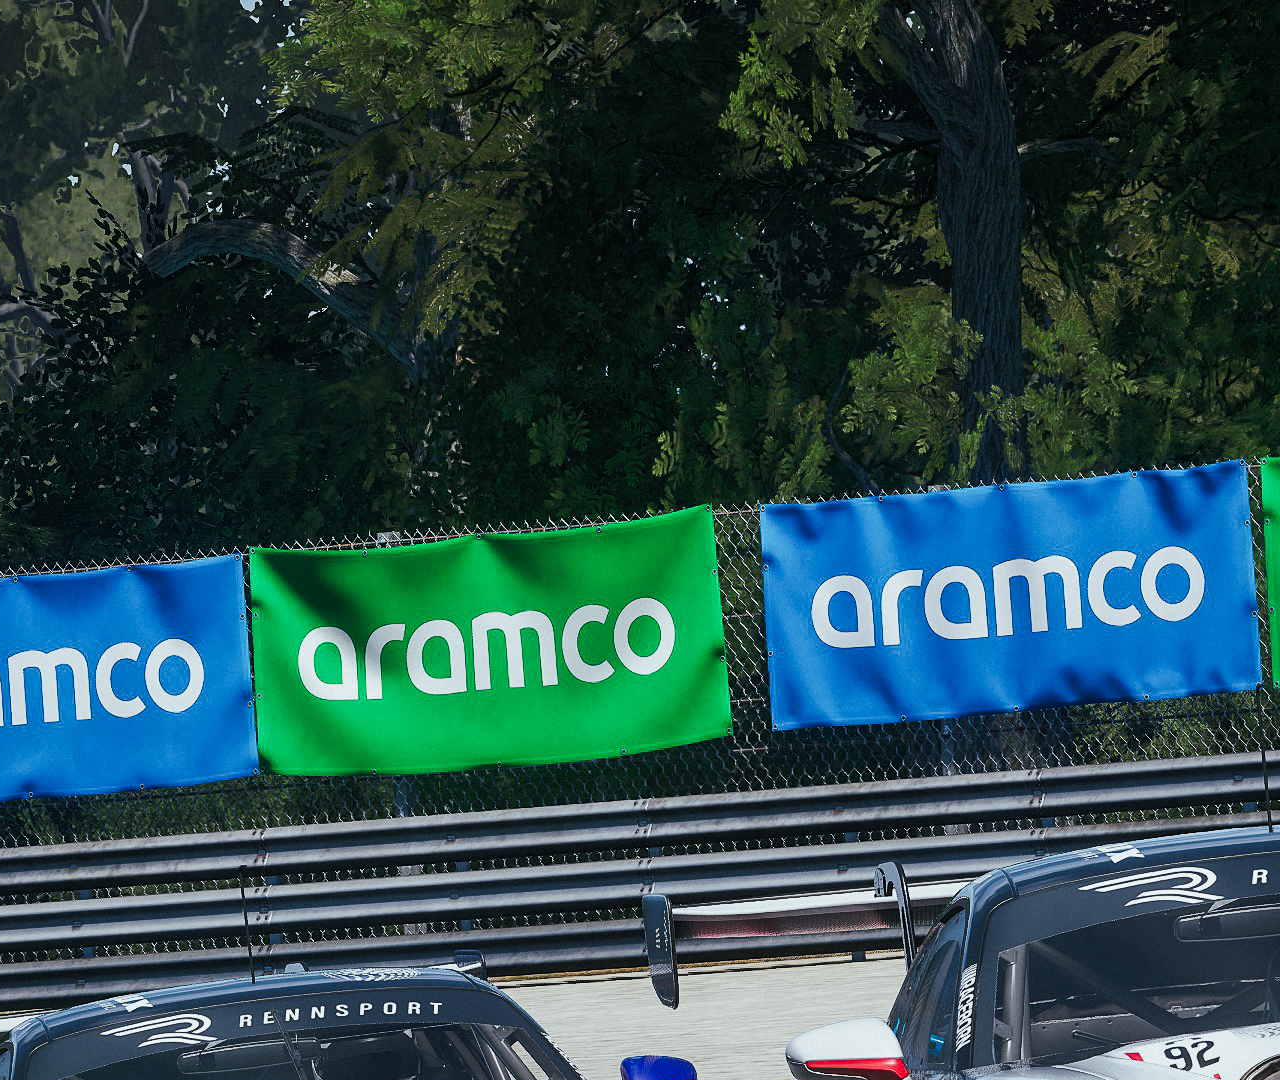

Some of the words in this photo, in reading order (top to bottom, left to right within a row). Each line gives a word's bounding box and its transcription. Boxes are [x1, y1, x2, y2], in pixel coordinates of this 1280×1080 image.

[811, 545, 1205, 649] aramco
[297, 597, 676, 701] aramco
[238, 1002, 443, 1028] RENNSPORT
[956, 974, 976, 1053] RACEBORN
[1163, 1040, 1220, 1071] 92
